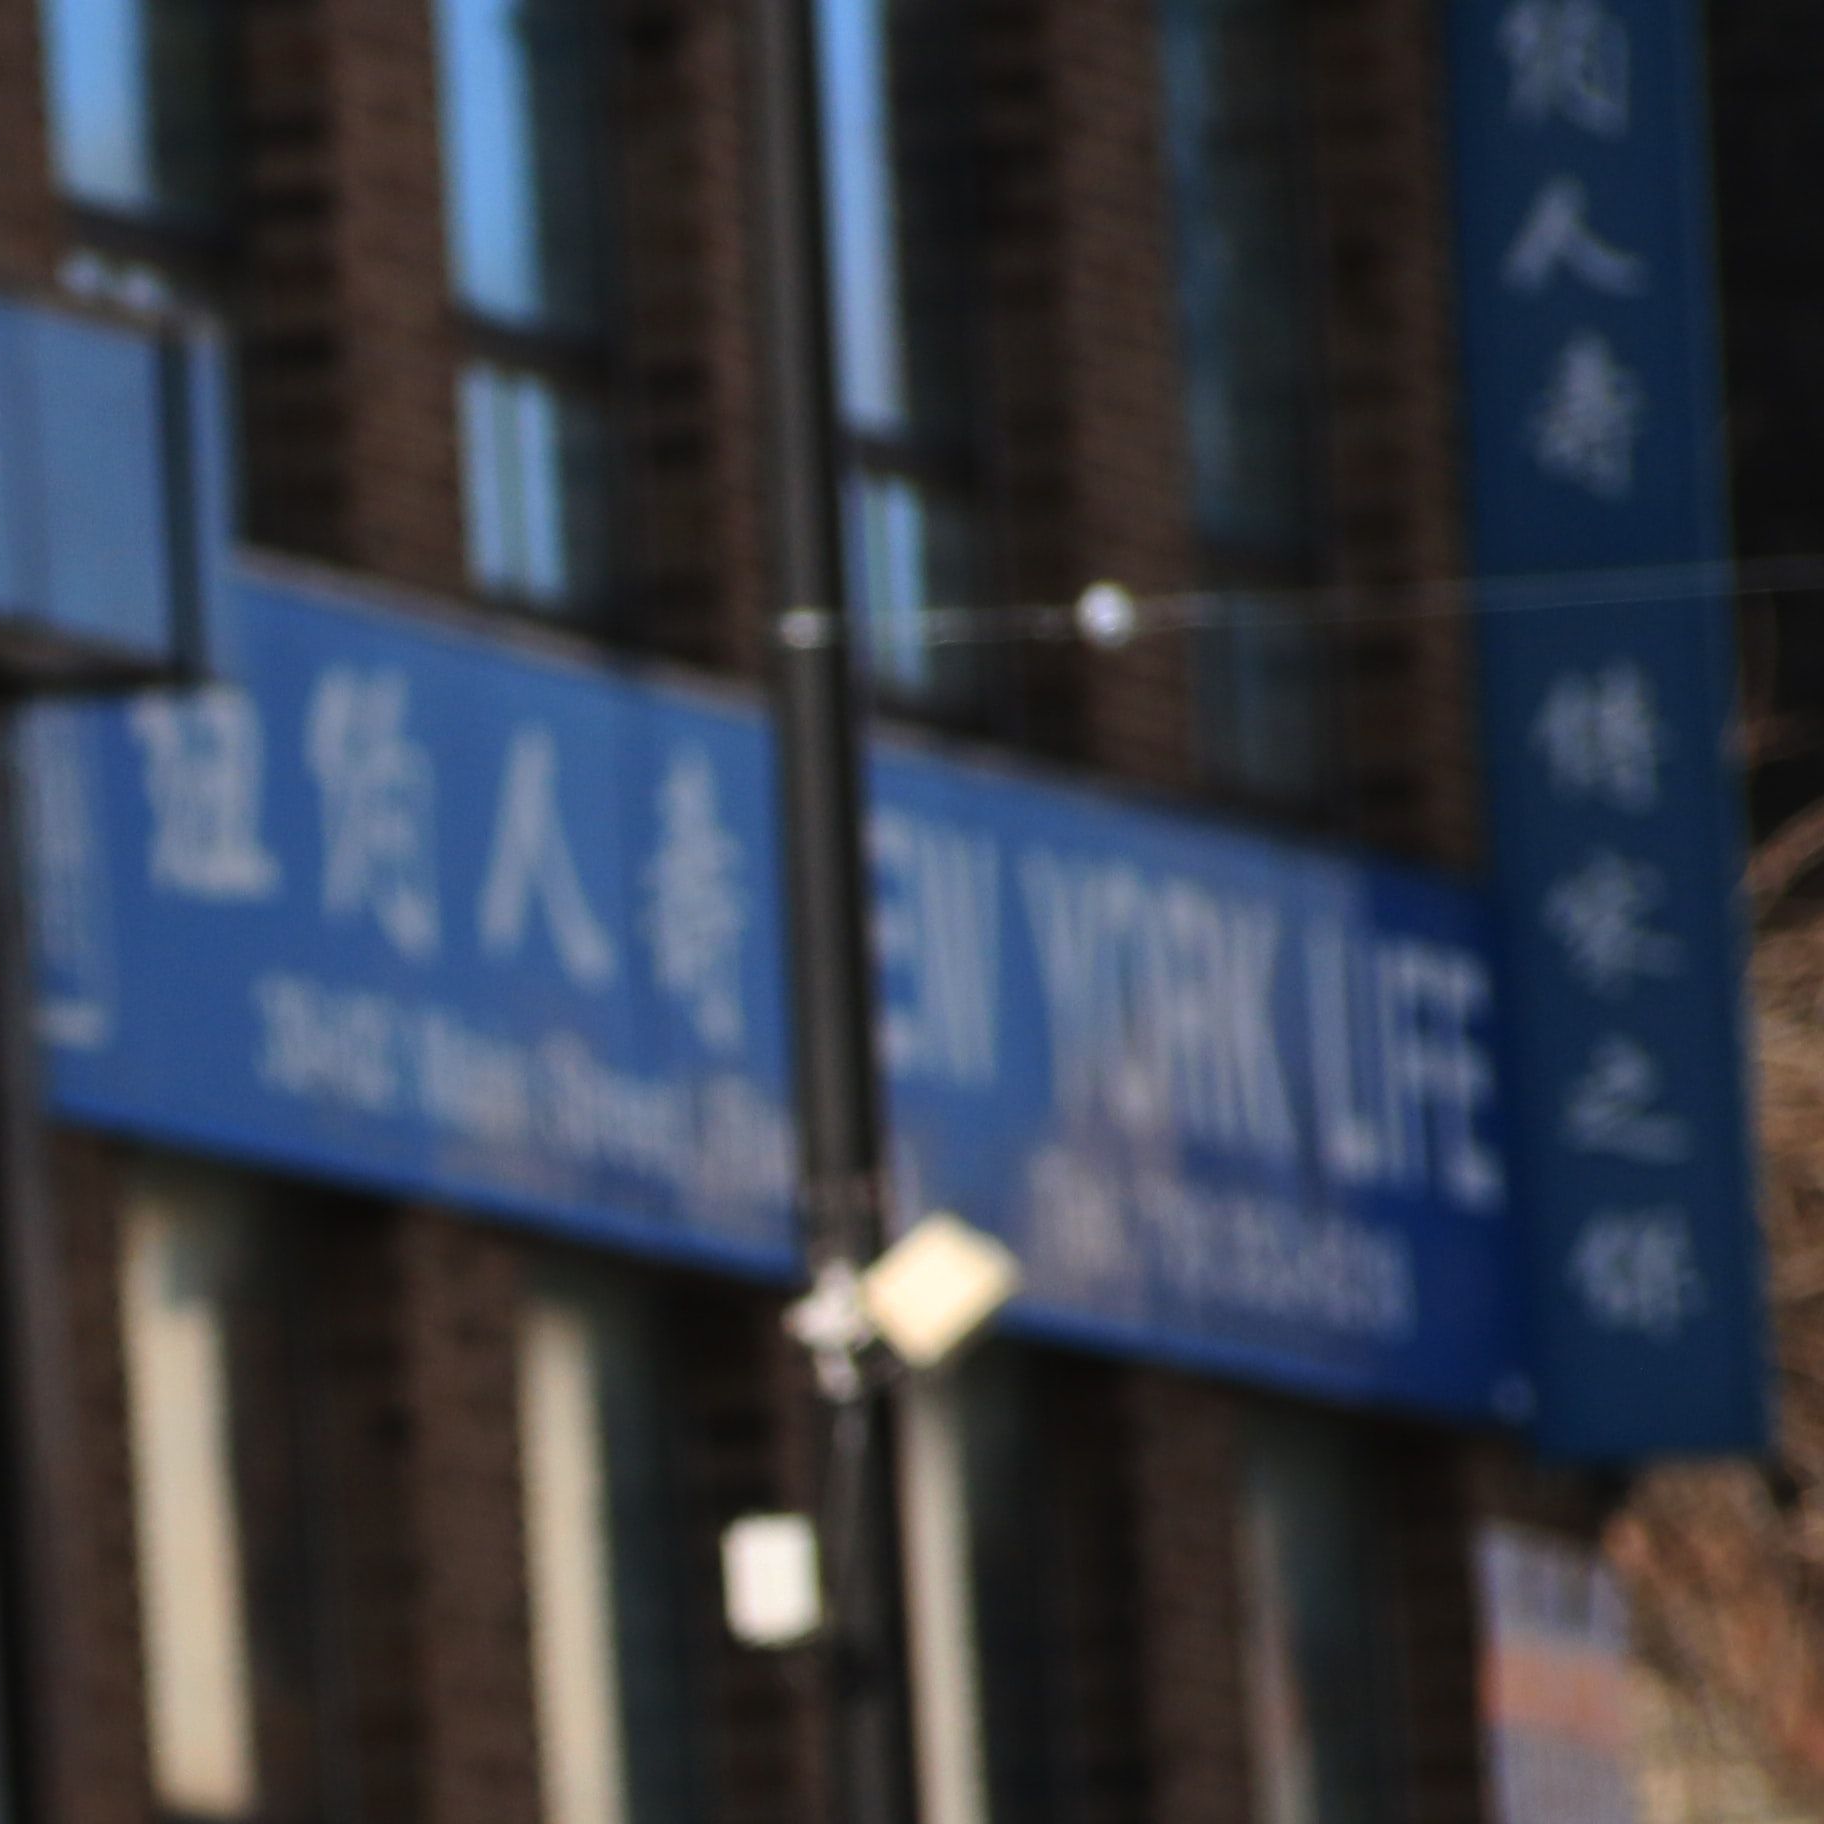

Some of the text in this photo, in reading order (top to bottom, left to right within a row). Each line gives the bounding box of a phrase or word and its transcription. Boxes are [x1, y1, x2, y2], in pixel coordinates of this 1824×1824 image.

[874, 812, 1002, 1085] EW
[1018, 850, 1298, 1160] YORK
[1304, 905, 1507, 1212] LIFE
